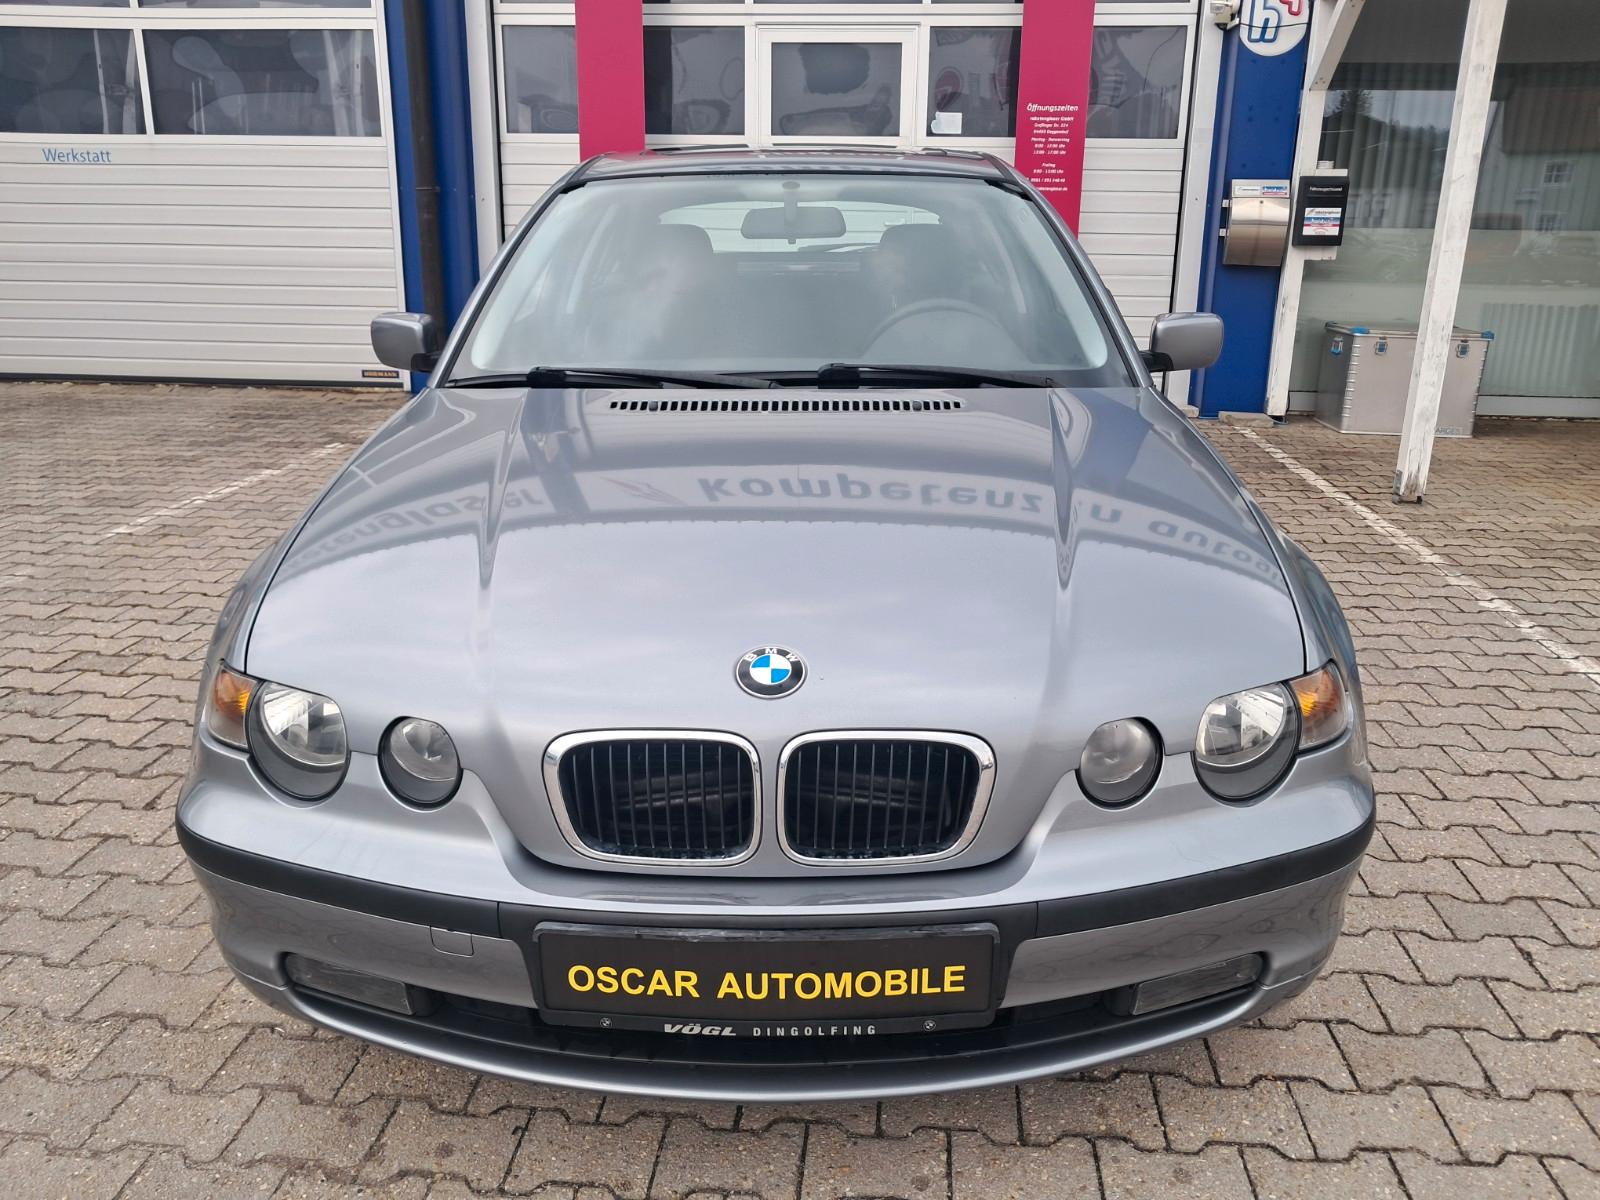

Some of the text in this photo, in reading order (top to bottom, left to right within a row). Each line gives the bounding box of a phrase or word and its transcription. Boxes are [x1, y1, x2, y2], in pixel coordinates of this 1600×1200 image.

[1026, 102, 1079, 112] Öffnungszeiten
[42, 148, 112, 163] Werkstatt
[568, 964, 966, 1000] OSCAR AUTOMOBILE
[664, 1023, 876, 1037] VÖGL DINGOLFING
